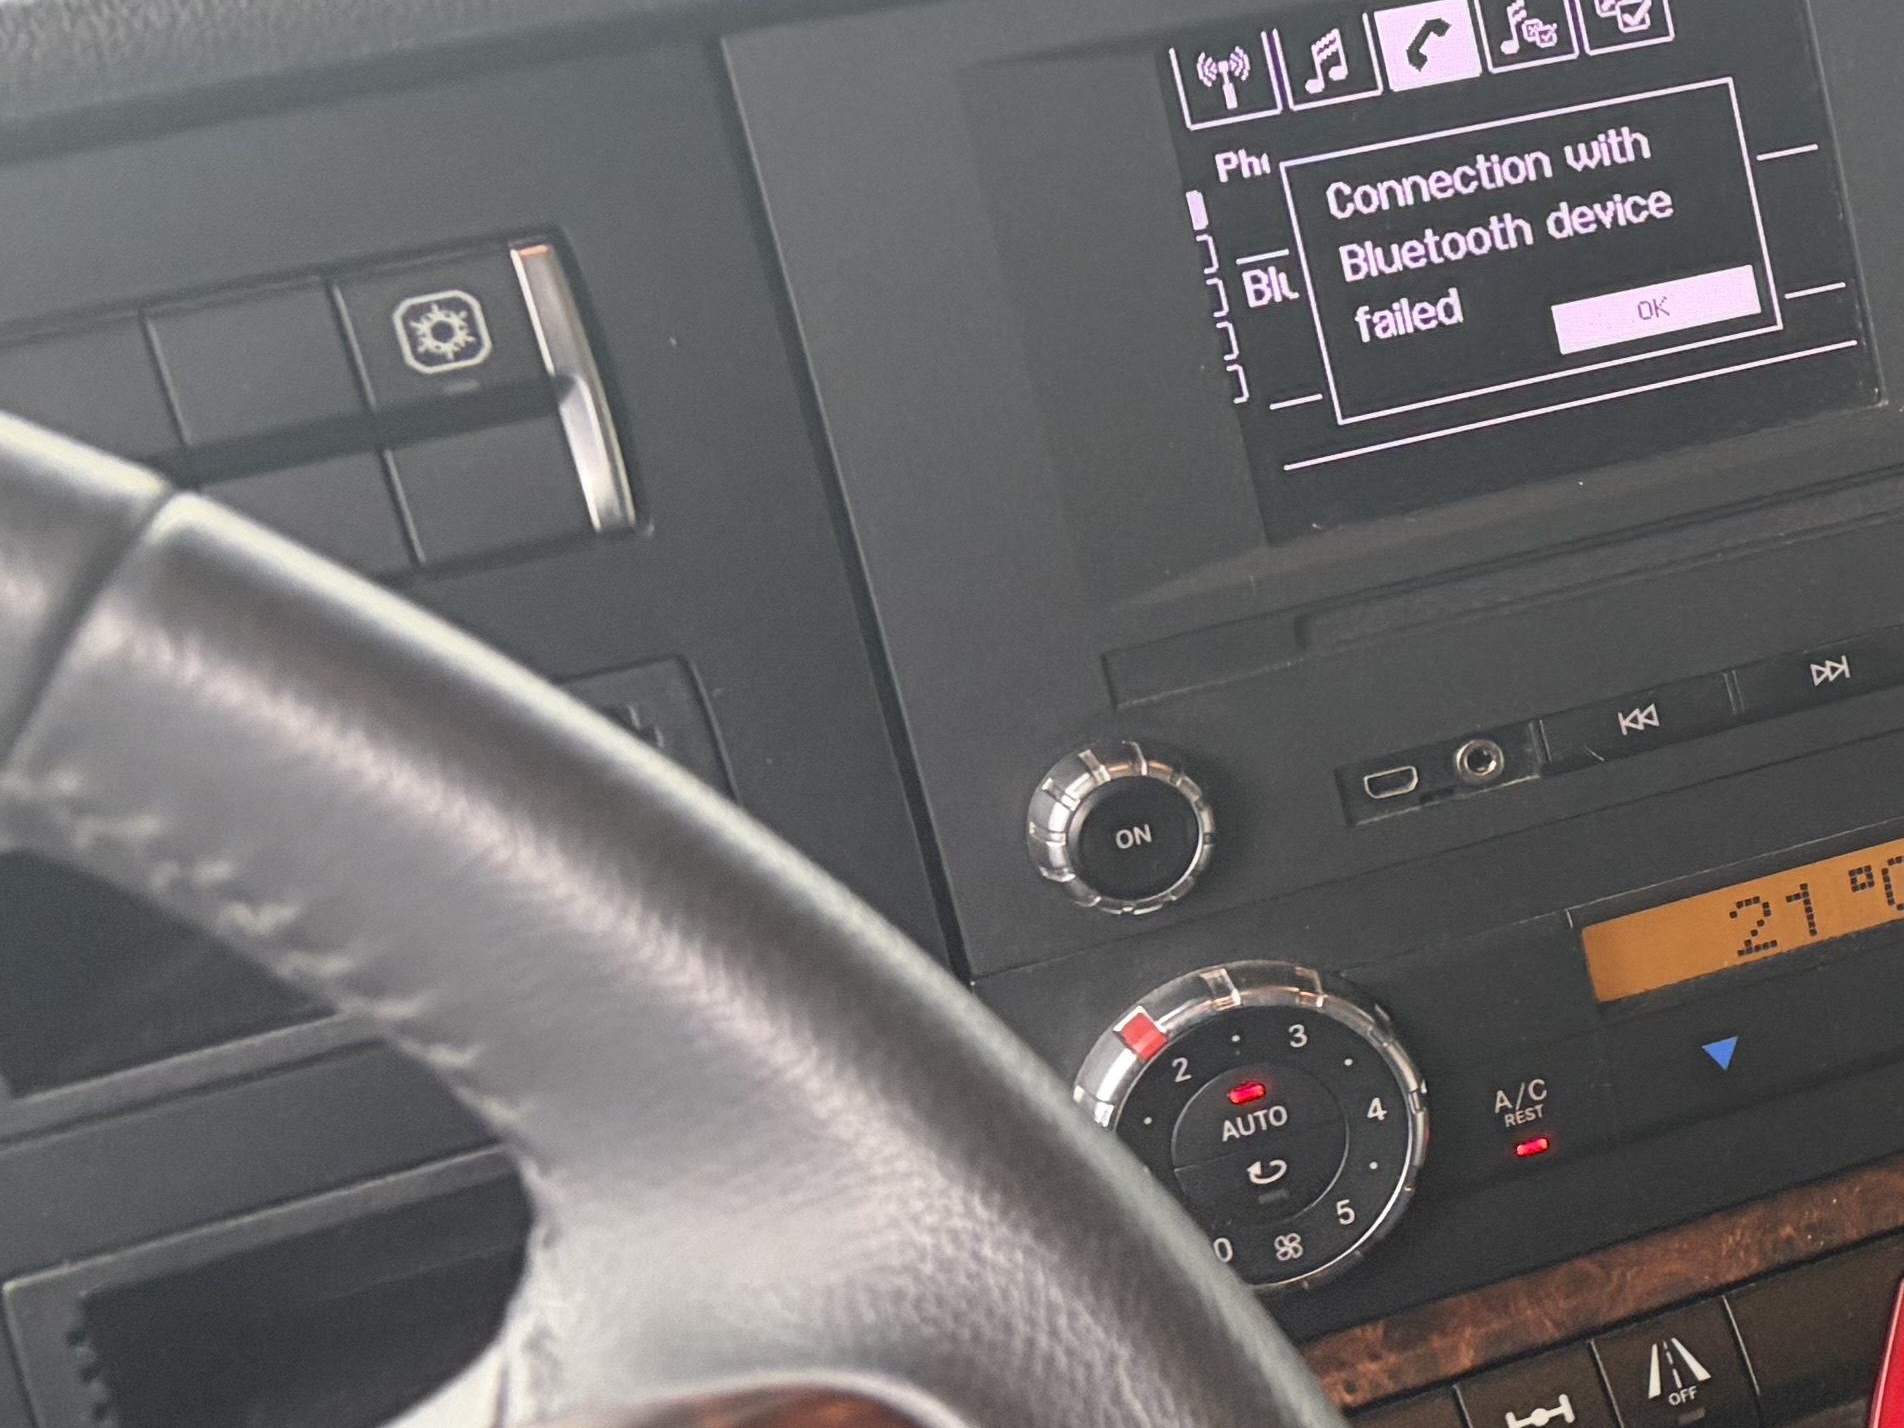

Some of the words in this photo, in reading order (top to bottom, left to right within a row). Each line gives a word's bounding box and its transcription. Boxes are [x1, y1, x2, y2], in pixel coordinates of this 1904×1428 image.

[1325, 150, 1553, 220] Connection
[1563, 126, 1652, 172] with
[1338, 212, 1534, 283] Bluetooth
[1545, 190, 1674, 240] device
[1354, 287, 1464, 343] failed
[1636, 295, 1671, 322] OK
[1115, 823, 1152, 849] ON
[1729, 883, 1818, 957] 21
[1288, 1023, 1308, 1048] 3
[1172, 1057, 1192, 1083] 2
[1367, 1097, 1387, 1121] 4
[1494, 1078, 1548, 1114] A/C
[1222, 1105, 1288, 1143] AUTO
[1504, 1104, 1544, 1128] REST
[1336, 1199, 1355, 1225] 5
[1213, 1237, 1233, 1263] 0
[1668, 1385, 1697, 1406] OFF
